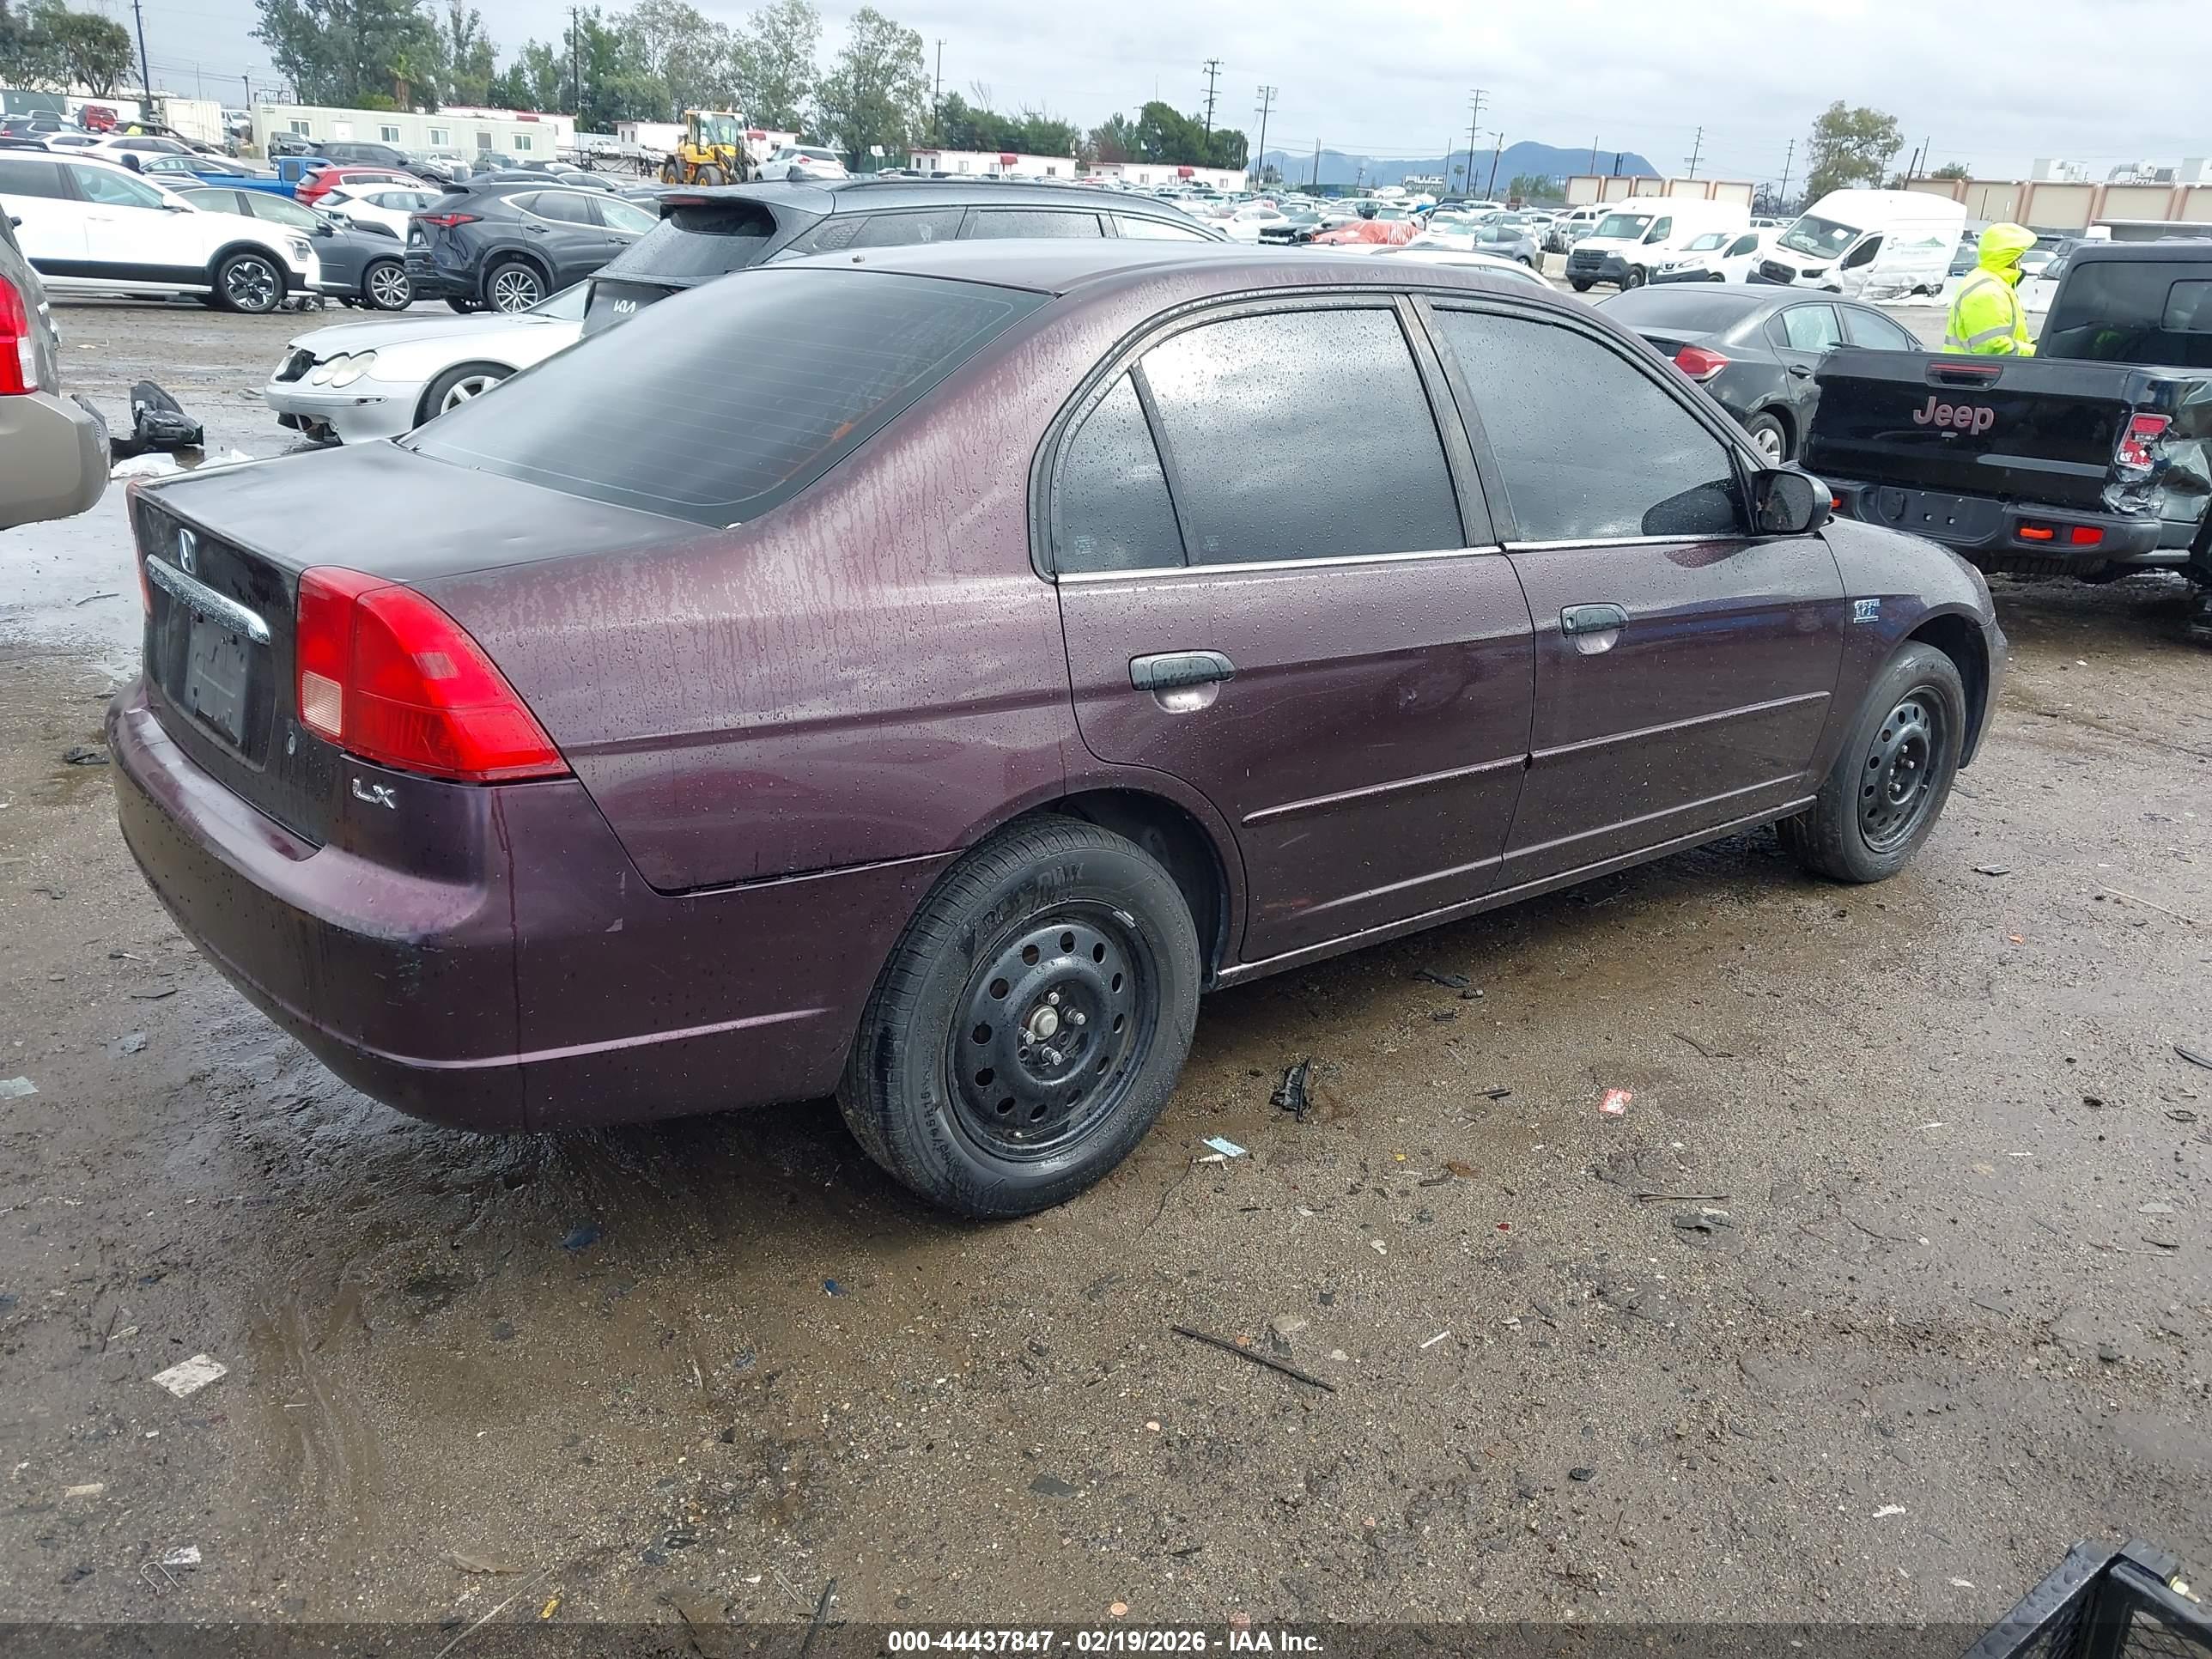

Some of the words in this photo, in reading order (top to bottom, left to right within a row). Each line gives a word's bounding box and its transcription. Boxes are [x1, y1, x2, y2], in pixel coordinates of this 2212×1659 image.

[613, 299, 636, 313] KIA
[1912, 395, 1995, 435] Jeep
[352, 778, 395, 810] LX
